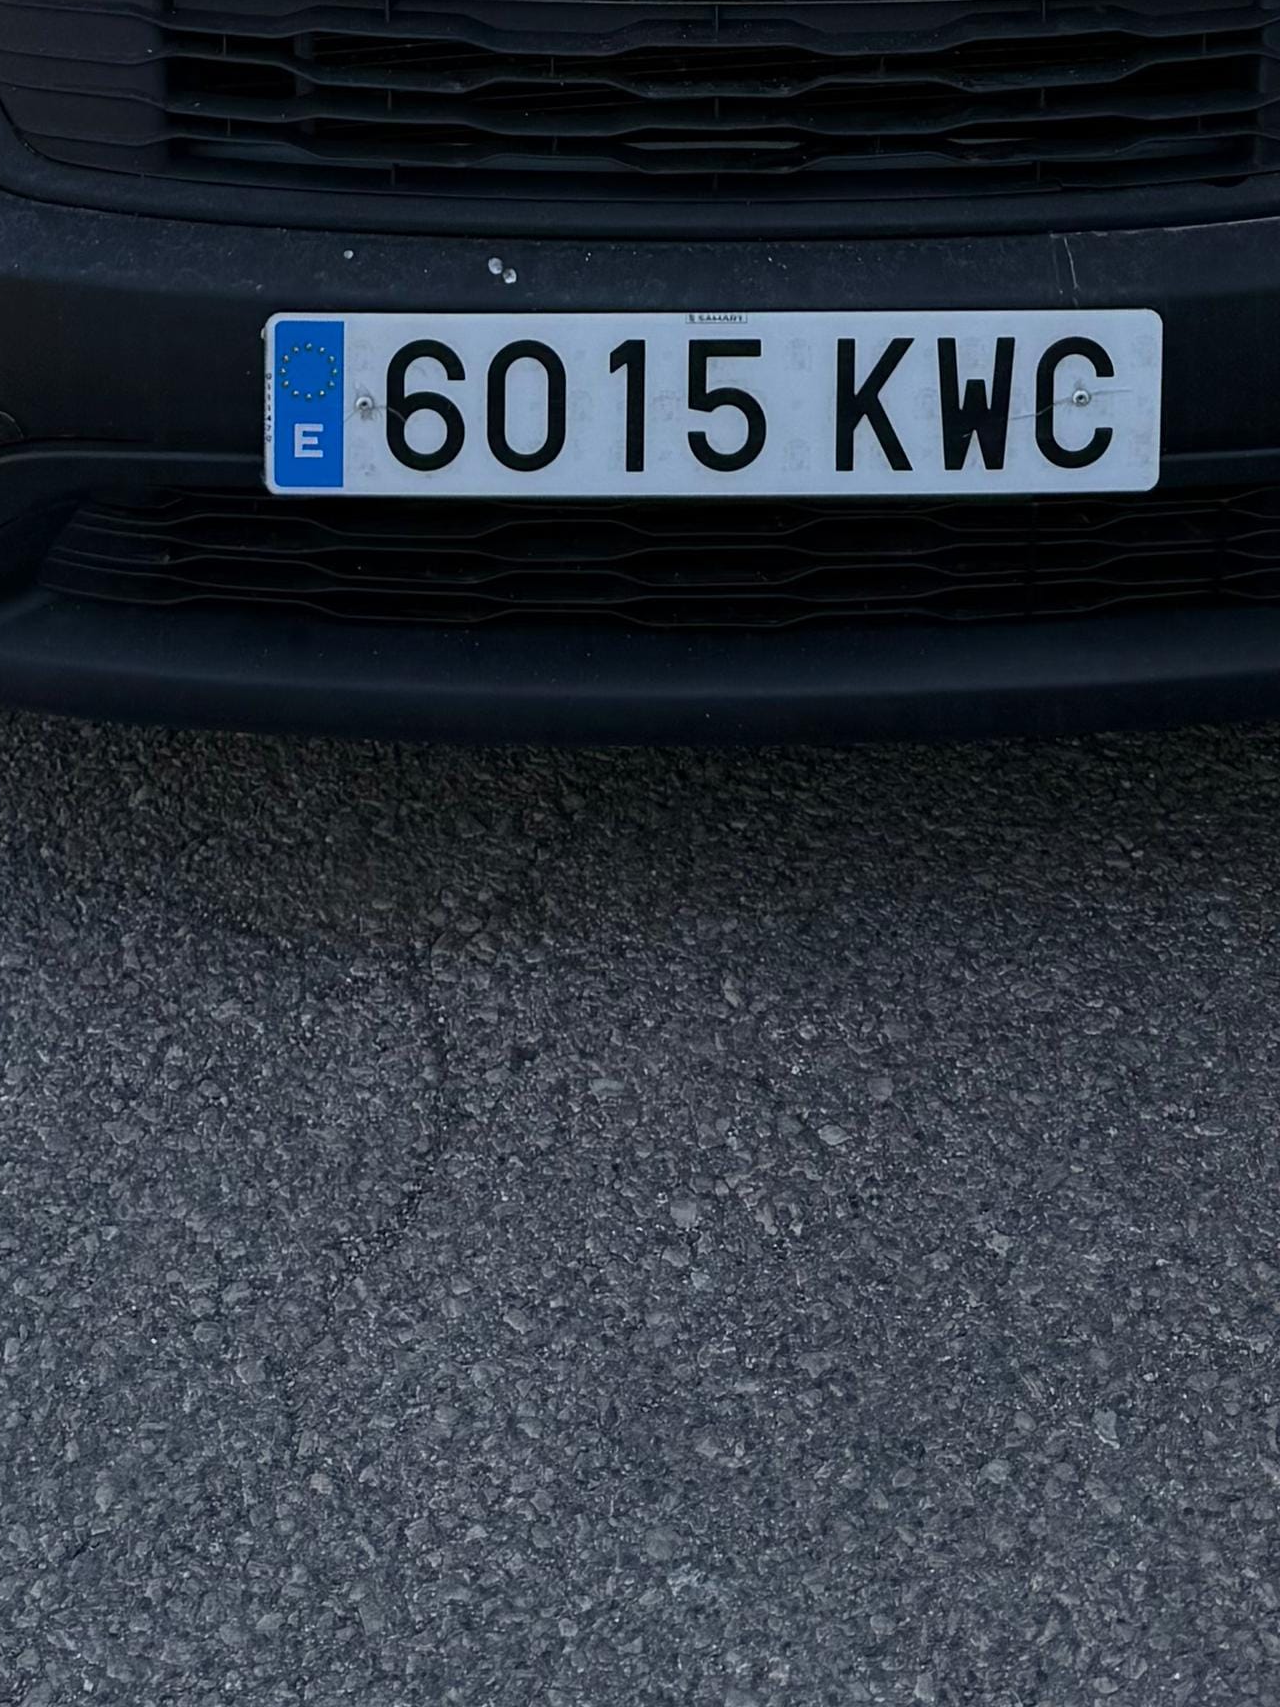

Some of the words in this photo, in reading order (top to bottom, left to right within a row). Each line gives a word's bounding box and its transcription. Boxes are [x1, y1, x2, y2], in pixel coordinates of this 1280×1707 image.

[294, 423, 324, 458] E
[384, 338, 768, 473] 6015
[835, 336, 1116, 472] KWC
